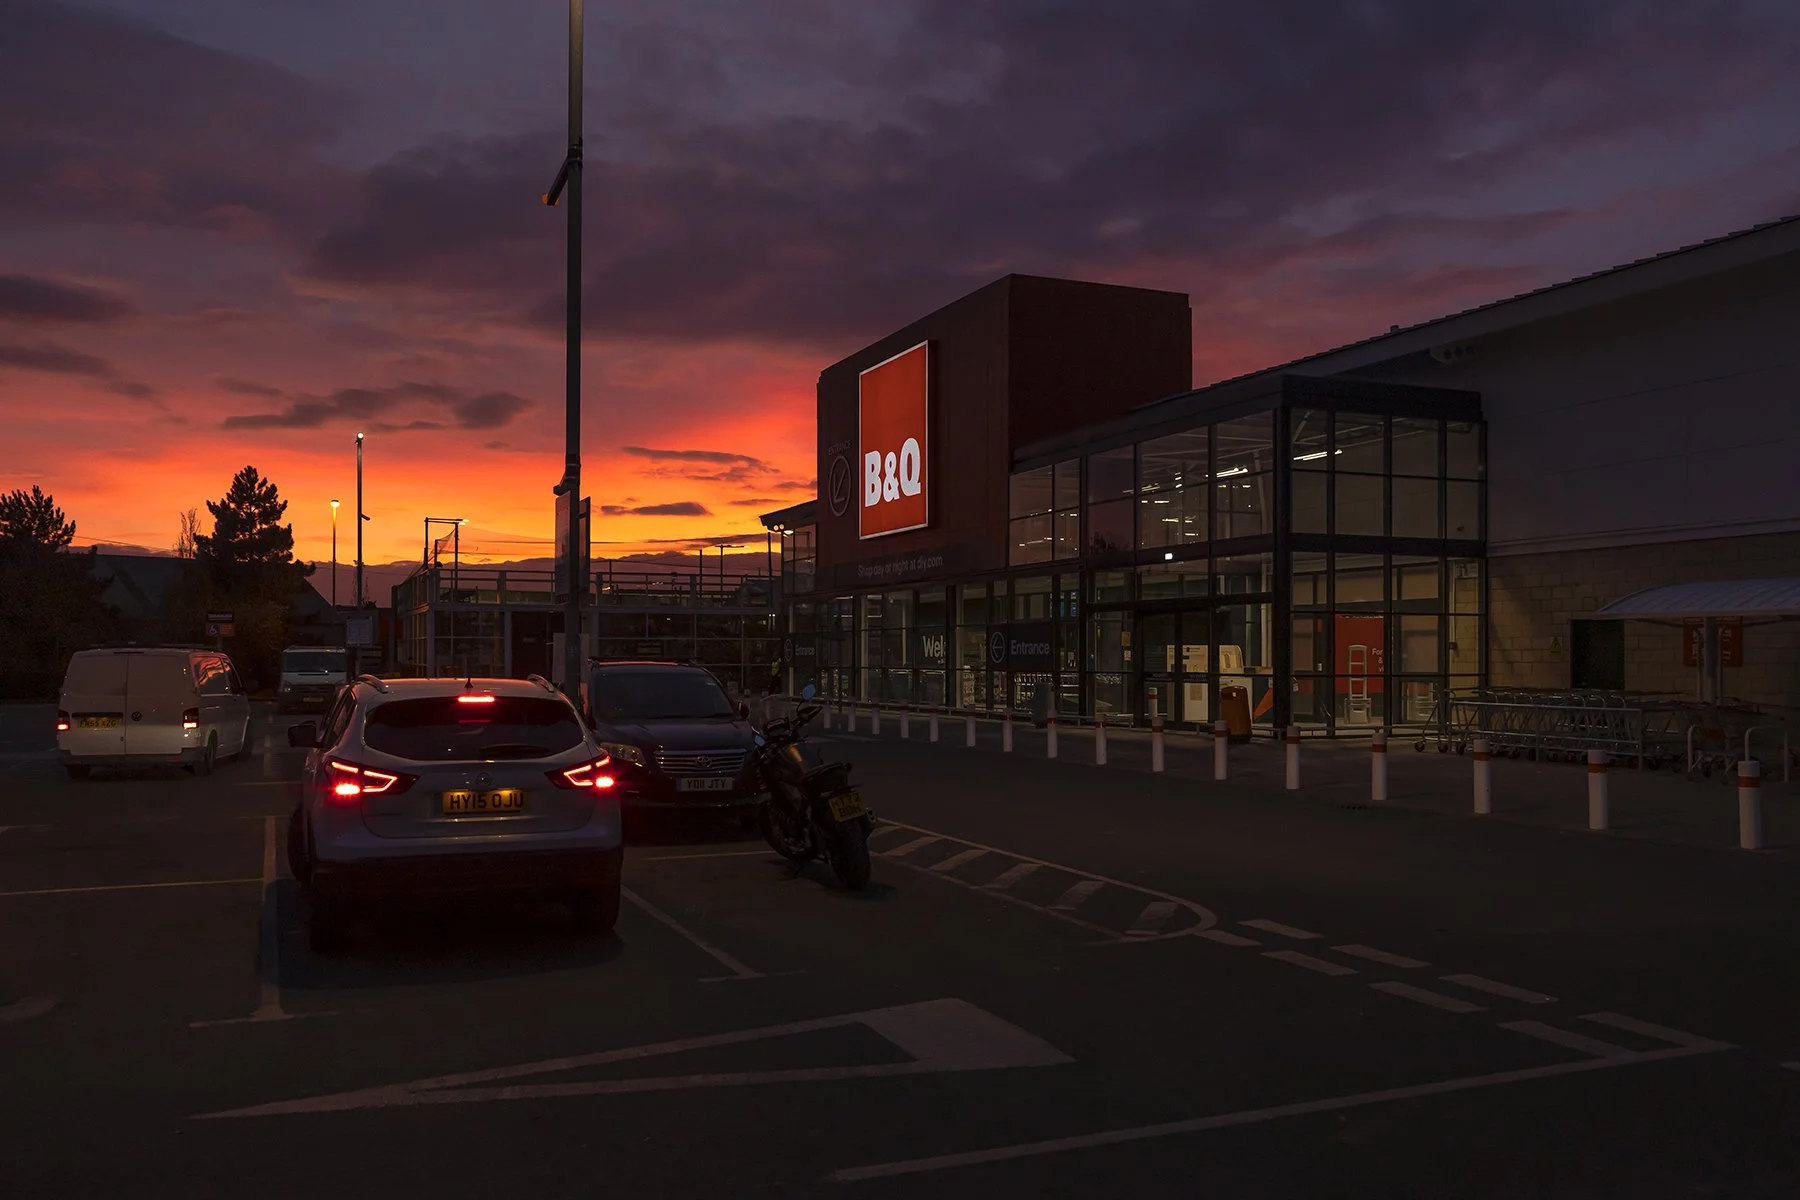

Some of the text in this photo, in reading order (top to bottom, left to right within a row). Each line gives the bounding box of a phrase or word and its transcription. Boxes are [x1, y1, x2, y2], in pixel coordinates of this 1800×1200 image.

[864, 437, 921, 508] B&Q
[857, 554, 943, 580] Shop day or night at diy.com
[795, 644, 815, 656] Entrance
[1010, 639, 1050, 656] Entrance
[707, 779, 726, 789] JTY
[449, 792, 524, 810] HY15 OJU
